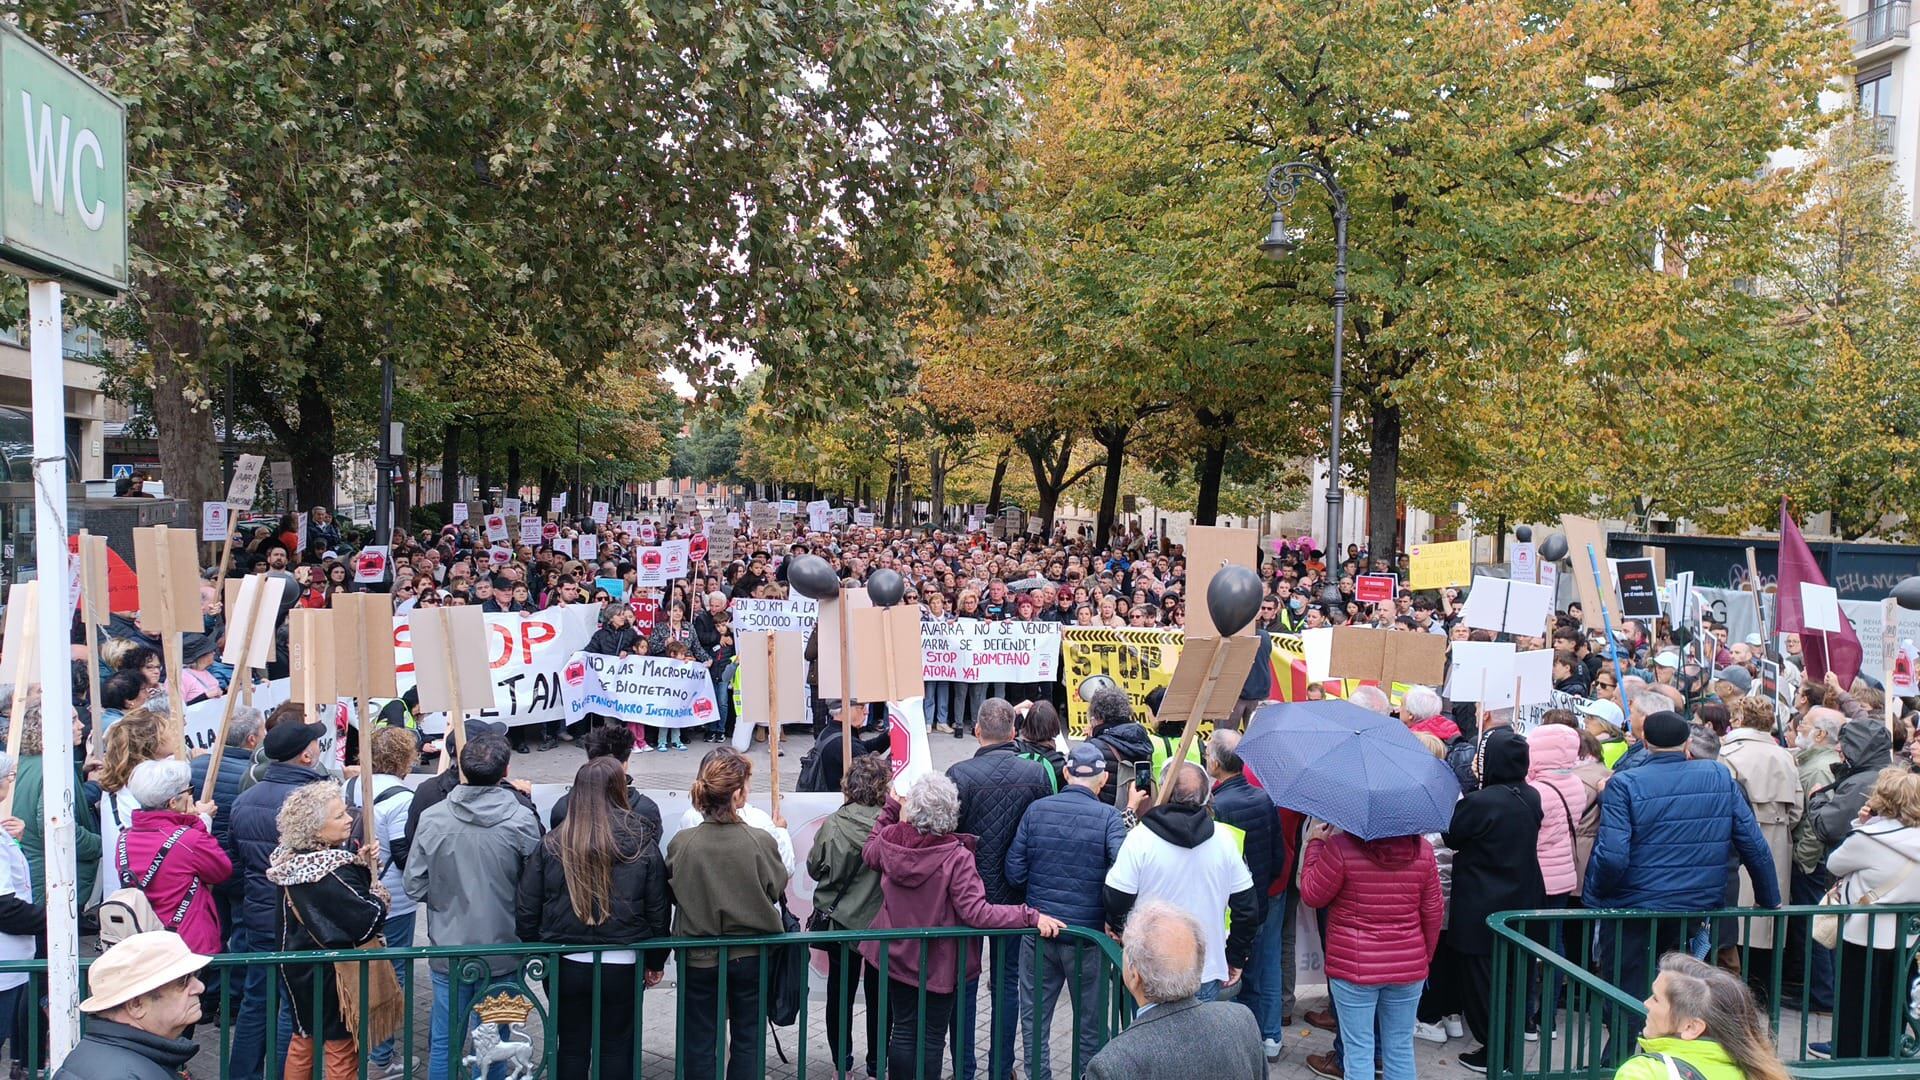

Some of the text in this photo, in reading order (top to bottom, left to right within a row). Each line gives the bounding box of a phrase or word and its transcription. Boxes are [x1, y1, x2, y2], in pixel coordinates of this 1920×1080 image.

[21, 89, 105, 231] WC
[736, 599, 815, 613] EN 30 KM A LA
[740, 614, 791, 627] +500.000
[974, 623, 990, 635] NO
[998, 622, 1013, 635] SE
[960, 639, 973, 651] SE
[926, 651, 958, 663] STOP
[1070, 643, 1162, 681] STOP
[585, 656, 604, 671] NO
[607, 664, 615, 675] A
[962, 667, 979, 681] YA!
[615, 679, 688, 701] BIOMETANO
[196, 728, 215, 749] LA
